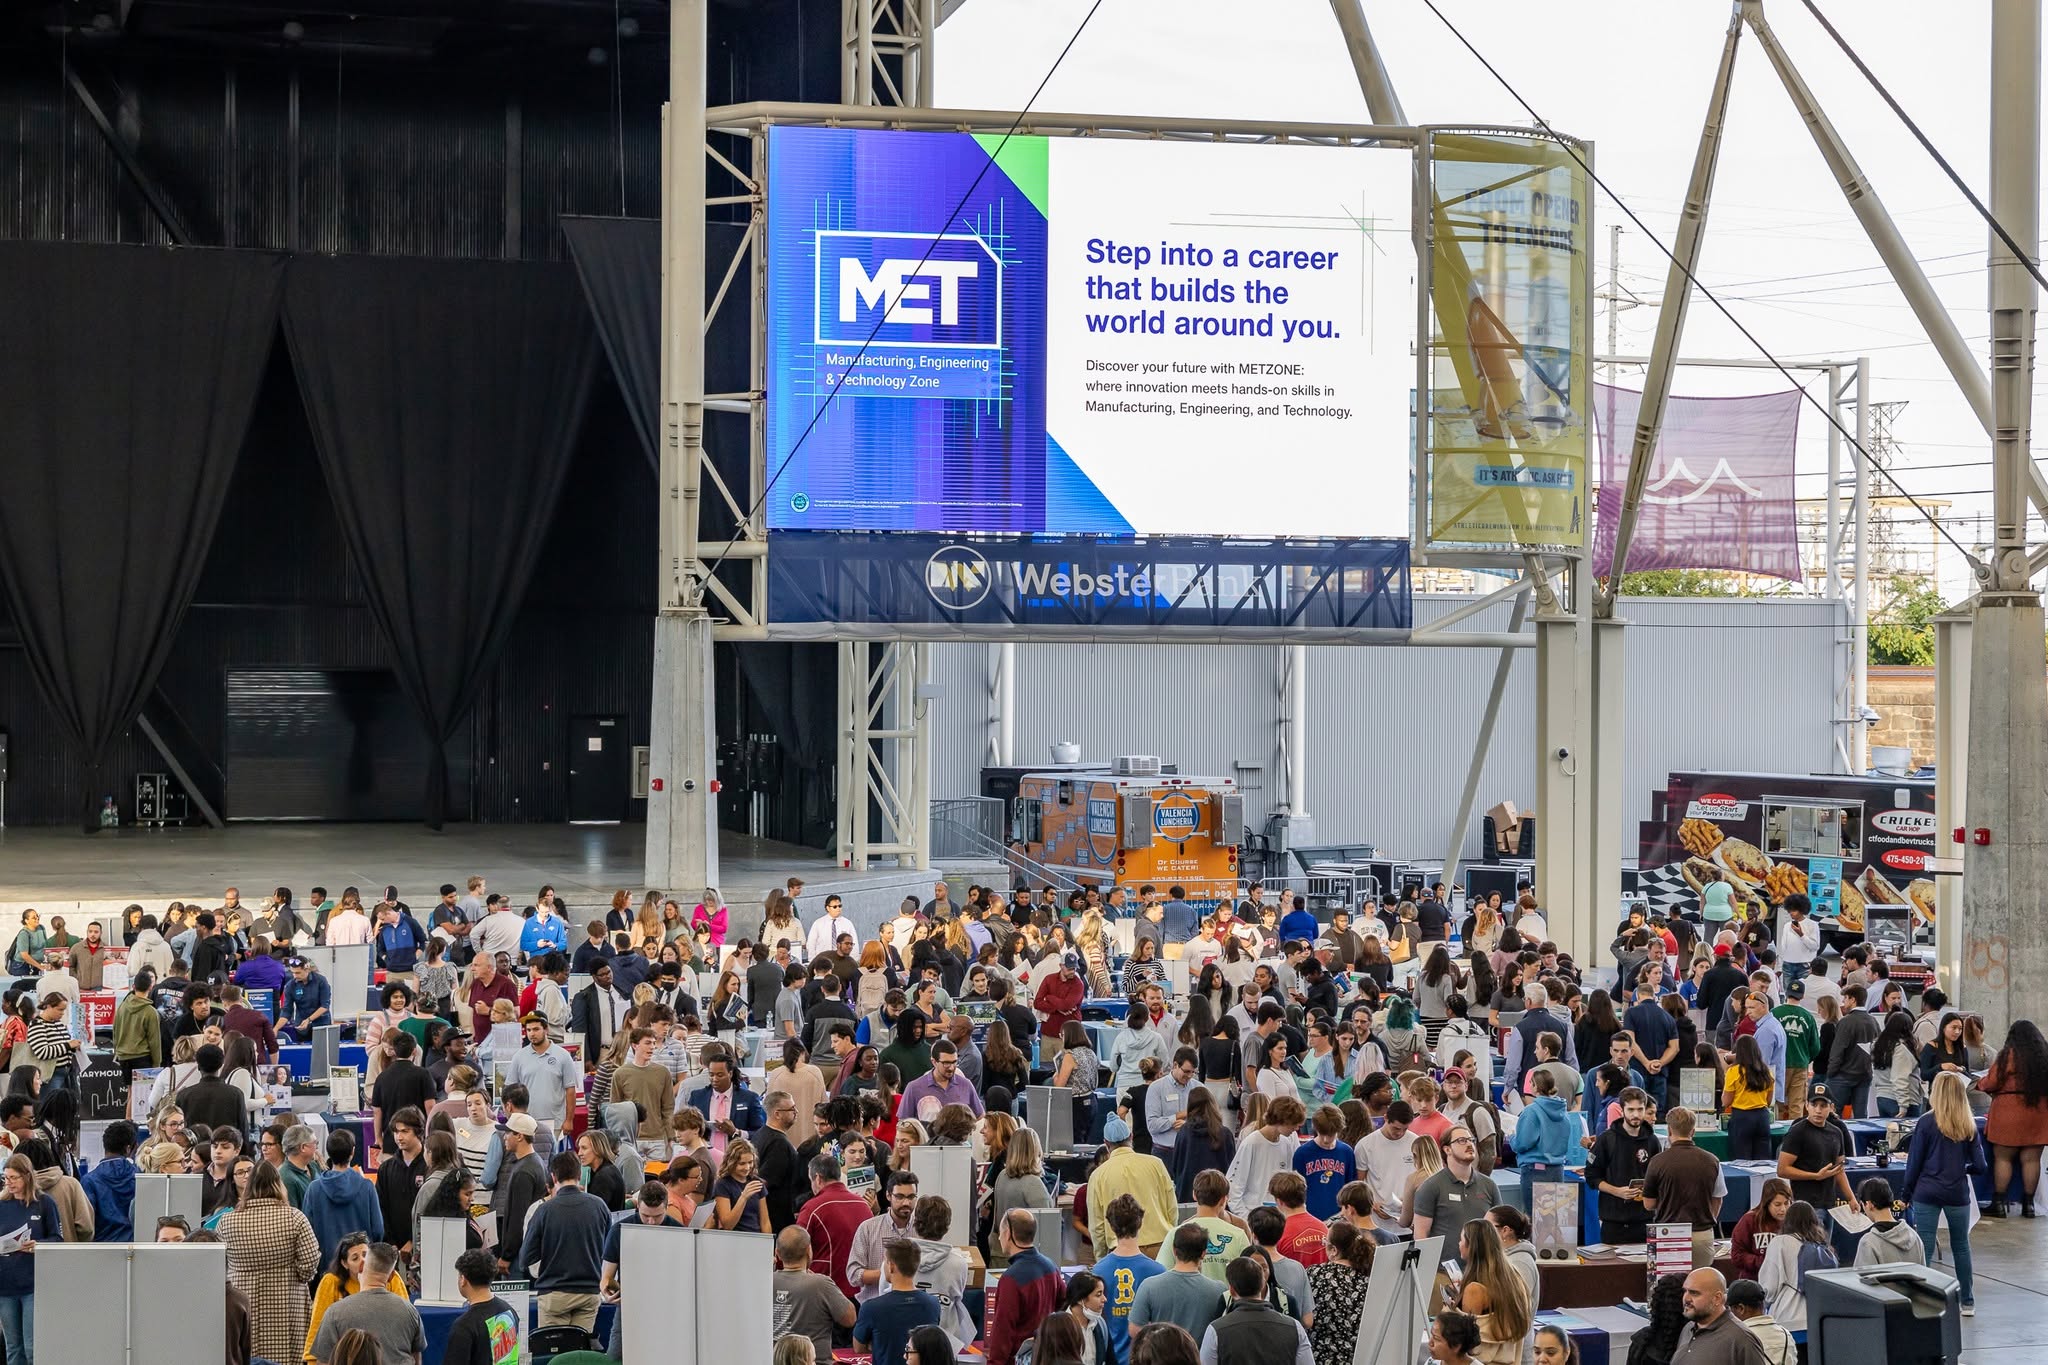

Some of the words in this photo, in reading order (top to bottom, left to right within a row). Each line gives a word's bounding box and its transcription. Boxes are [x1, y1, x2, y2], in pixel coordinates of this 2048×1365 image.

[1086, 238, 1151, 270] Step
[1161, 241, 1213, 267] into
[1223, 249, 1239, 268] a
[1248, 249, 1339, 270] career
[839, 257, 979, 326] MET
[1086, 275, 1142, 301] that
[1151, 277, 1235, 304] builds
[1244, 280, 1289, 305] the
[1086, 310, 1165, 335] world
[1174, 313, 1273, 337] around
[1282, 320, 1340, 344] you.
[826, 352, 917, 370] Manufacturing,
[919, 356, 990, 371] Engineering
[1086, 359, 1140, 373] Discover
[1142, 362, 1169, 375] your
[1172, 361, 1207, 374] future
[1210, 362, 1236, 375] with
[1239, 363, 1305, 376] METZONE:
[825, 373, 835, 386] &
[838, 373, 906, 388] Technology
[909, 375, 940, 388] Zone
[1086, 380, 1122, 393] where
[1126, 381, 1188, 395] innovation
[1191, 383, 1228, 396] meets
[1231, 383, 1288, 397] hands-on
[1291, 384, 1321, 397] skills
[1324, 385, 1335, 397] in
[1085, 400, 1176, 416] Manufacturing,
[1180, 402, 1254, 418] Engineering,
[1257, 404, 1280, 417] and
[1282, 404, 1353, 420] Technology.
[1480, 470, 1499, 481] IT'S
[143, 803, 152, 814] 24
[1161, 808, 1193, 818] VALENCIA
[1161, 818, 1193, 826] LUNCHERIA
[1305, 1158, 1345, 1177] KANSAS
[1113, 1267, 1135, 1305] B
